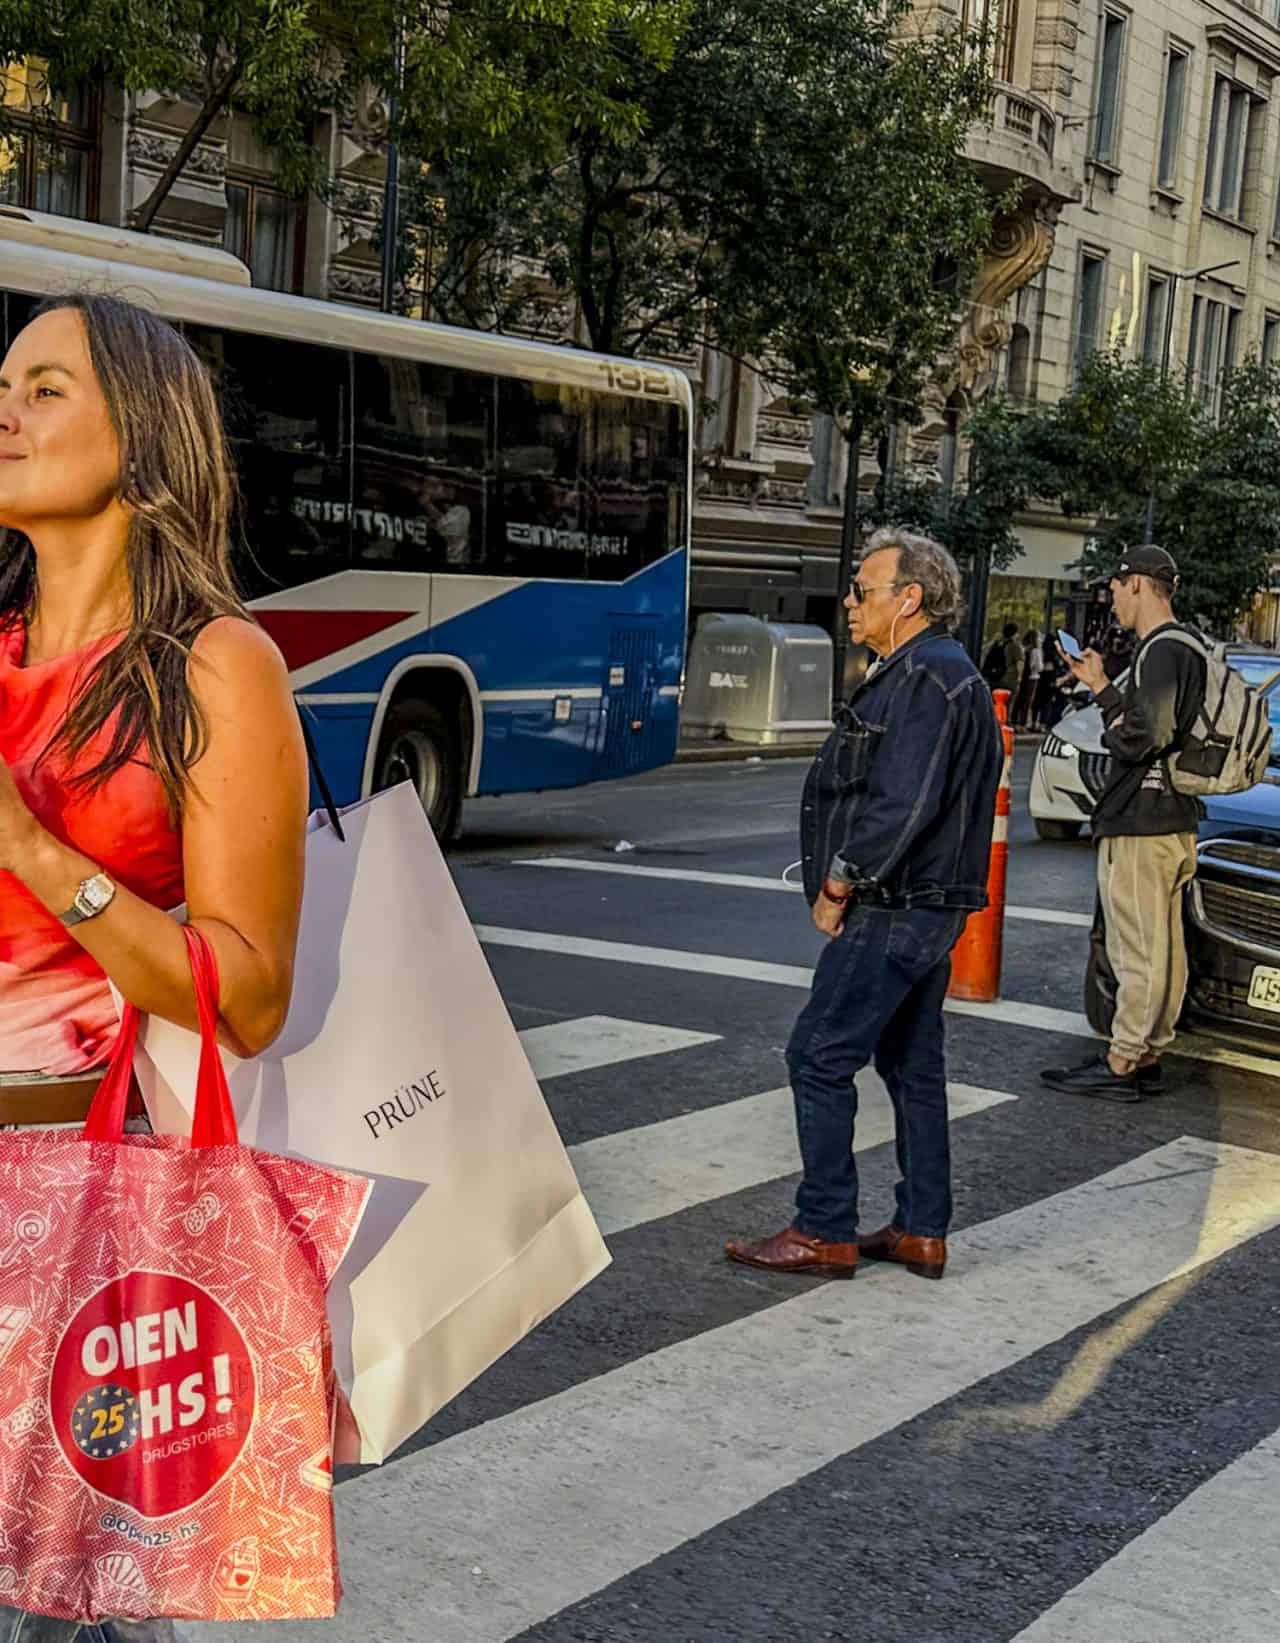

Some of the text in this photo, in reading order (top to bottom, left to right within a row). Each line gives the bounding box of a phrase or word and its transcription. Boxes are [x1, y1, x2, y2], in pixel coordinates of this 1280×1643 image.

[363, 1069, 446, 1140] PRÜNE
[90, 1403, 125, 1440] 25
[141, 1421, 236, 1464] DRUGSTORES
